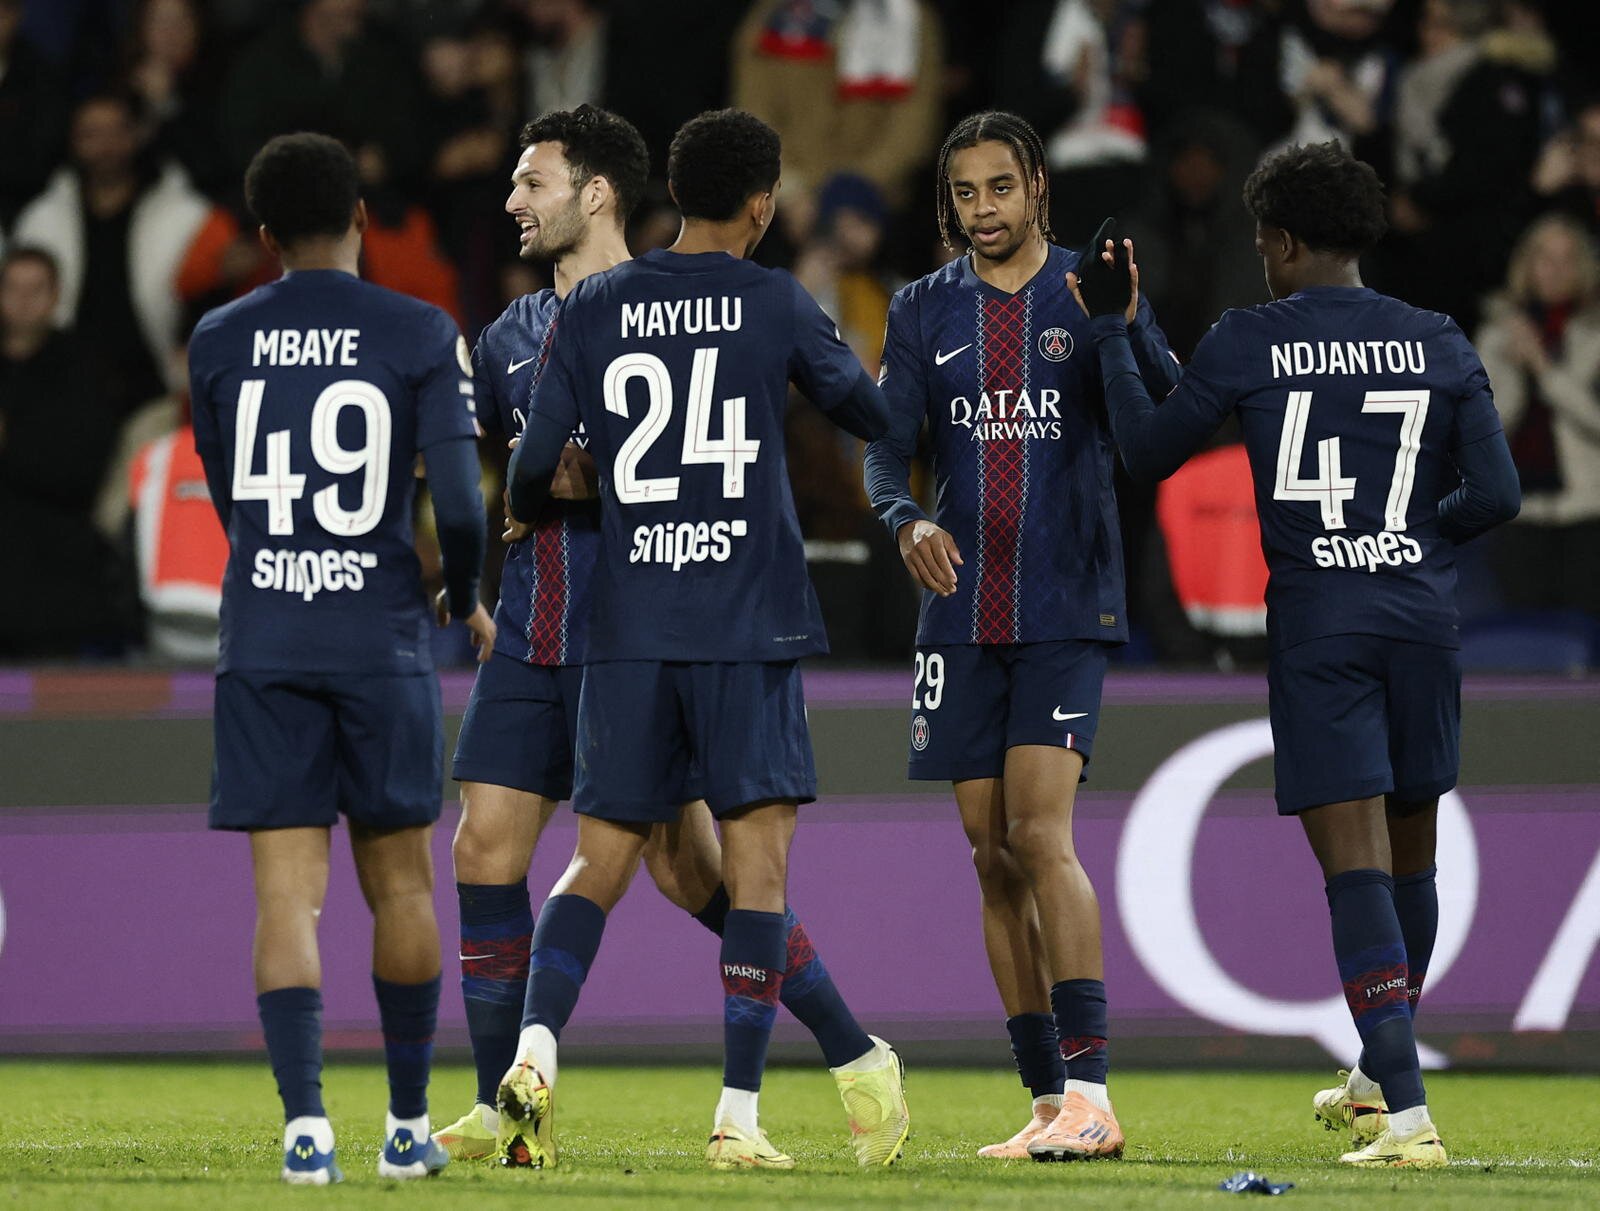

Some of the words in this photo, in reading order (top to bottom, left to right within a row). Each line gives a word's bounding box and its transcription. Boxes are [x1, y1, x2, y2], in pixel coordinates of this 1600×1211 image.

[621, 296, 742, 338] MAYULU
[1044, 330, 1068, 338] PARIS
[252, 329, 361, 367] MBAYE
[1271, 341, 1426, 379] NDJANTOU
[603, 348, 761, 504] 24
[950, 389, 1062, 429] QATAR
[970, 421, 1062, 441] AIRWAYS
[232, 379, 392, 536] 49
[1273, 390, 1431, 532] 47
[629, 520, 733, 572] snipes
[1311, 531, 1423, 573] snipes
[251, 548, 365, 602] snipes
[912, 652, 945, 710] 29
[724, 965, 766, 982] PARIS
[1366, 977, 1406, 998] PARIS
